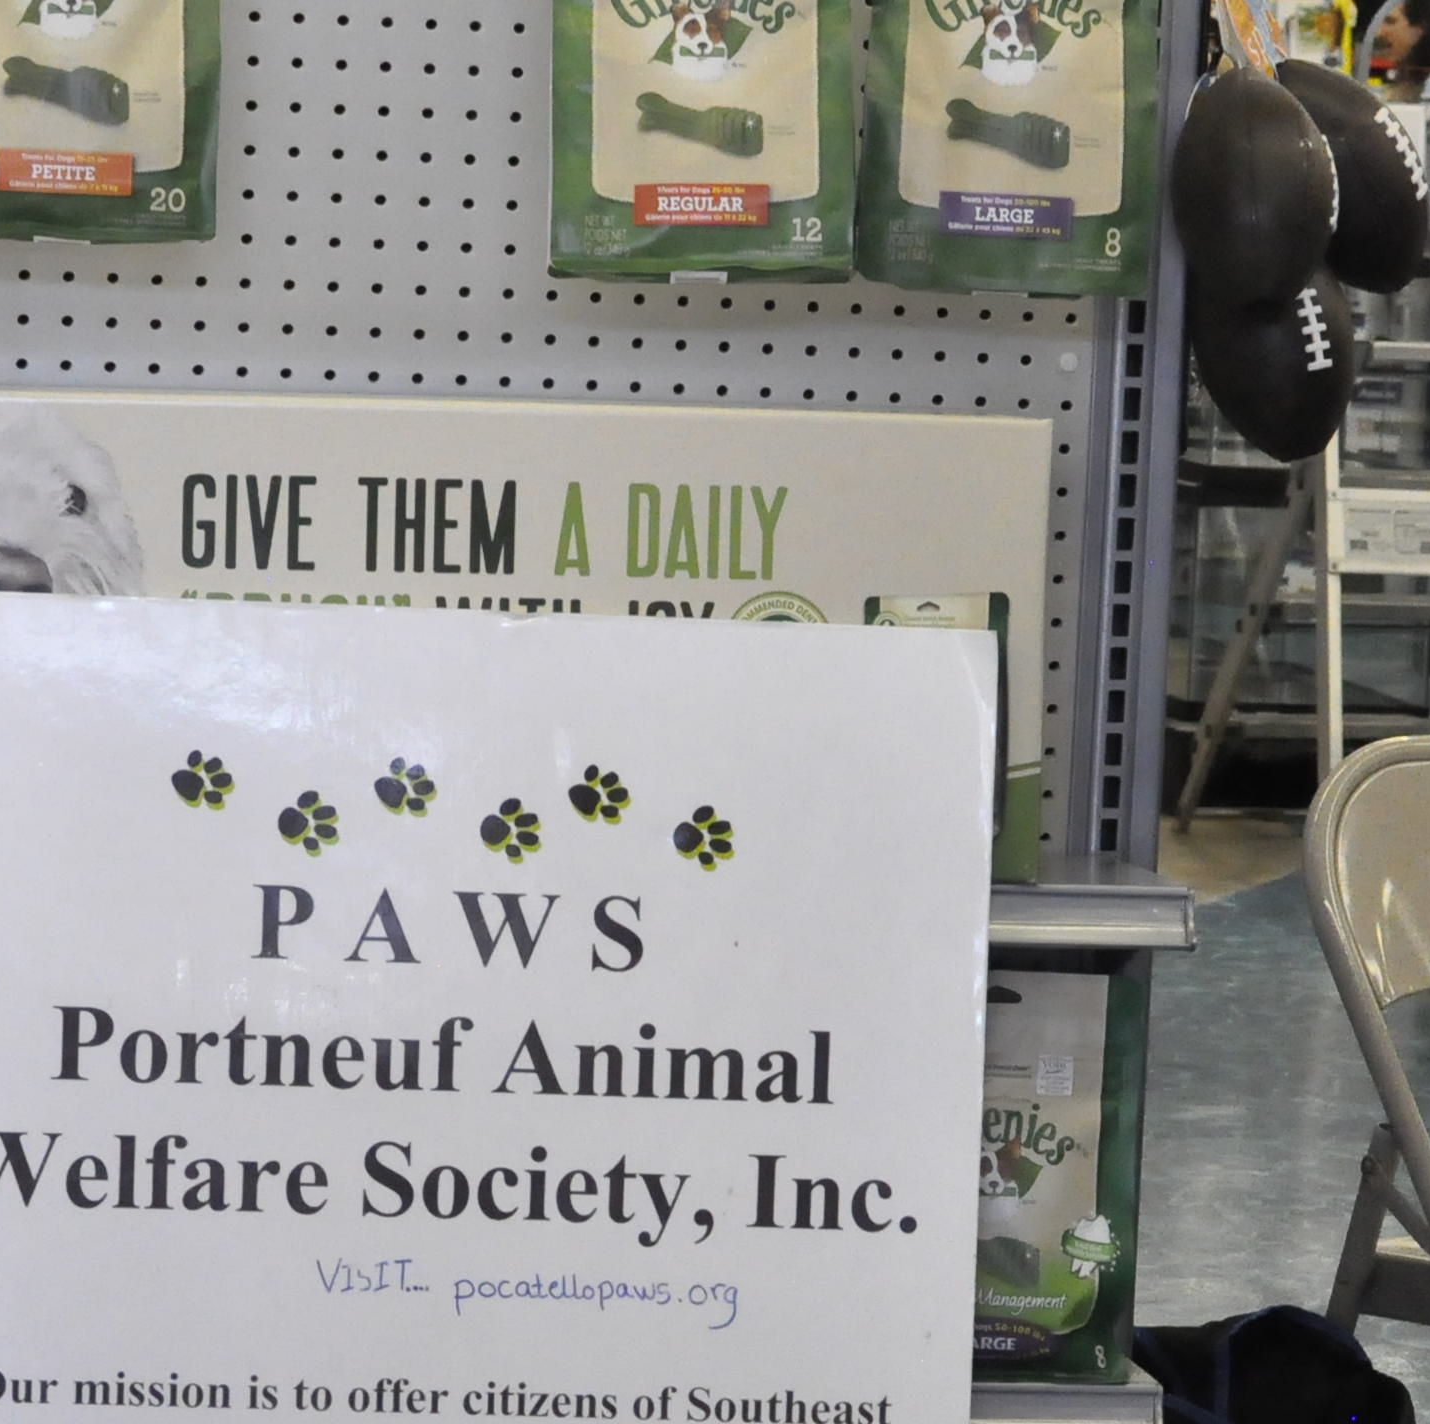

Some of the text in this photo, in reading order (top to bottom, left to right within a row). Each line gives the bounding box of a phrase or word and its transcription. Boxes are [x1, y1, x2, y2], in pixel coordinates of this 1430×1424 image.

[31, 163, 96, 181] PETITE
[149, 187, 187, 213] 20
[657, 196, 744, 212] REGULAR
[791, 216, 823, 243] 12
[975, 206, 1035, 225] LARGE
[1104, 227, 1122, 258] 8
[180, 473, 788, 581] GIVE THEM A DAILY
[51, 1006, 833, 1104] Portneuf Animal
[362, 1141, 714, 1247] Society,
[746, 1154, 917, 1234] Inc.
[454, 1274, 737, 1329] pocatellopaws.org
[1094, 1344, 1107, 1369] 8
[74, 1371, 231, 1408] mission
[248, 1375, 278, 1410] is
[294, 1380, 332, 1411] to
[348, 1378, 449, 1414] offer
[463, 1381, 617, 1419] citizens
[633, 1386, 677, 1420] of
